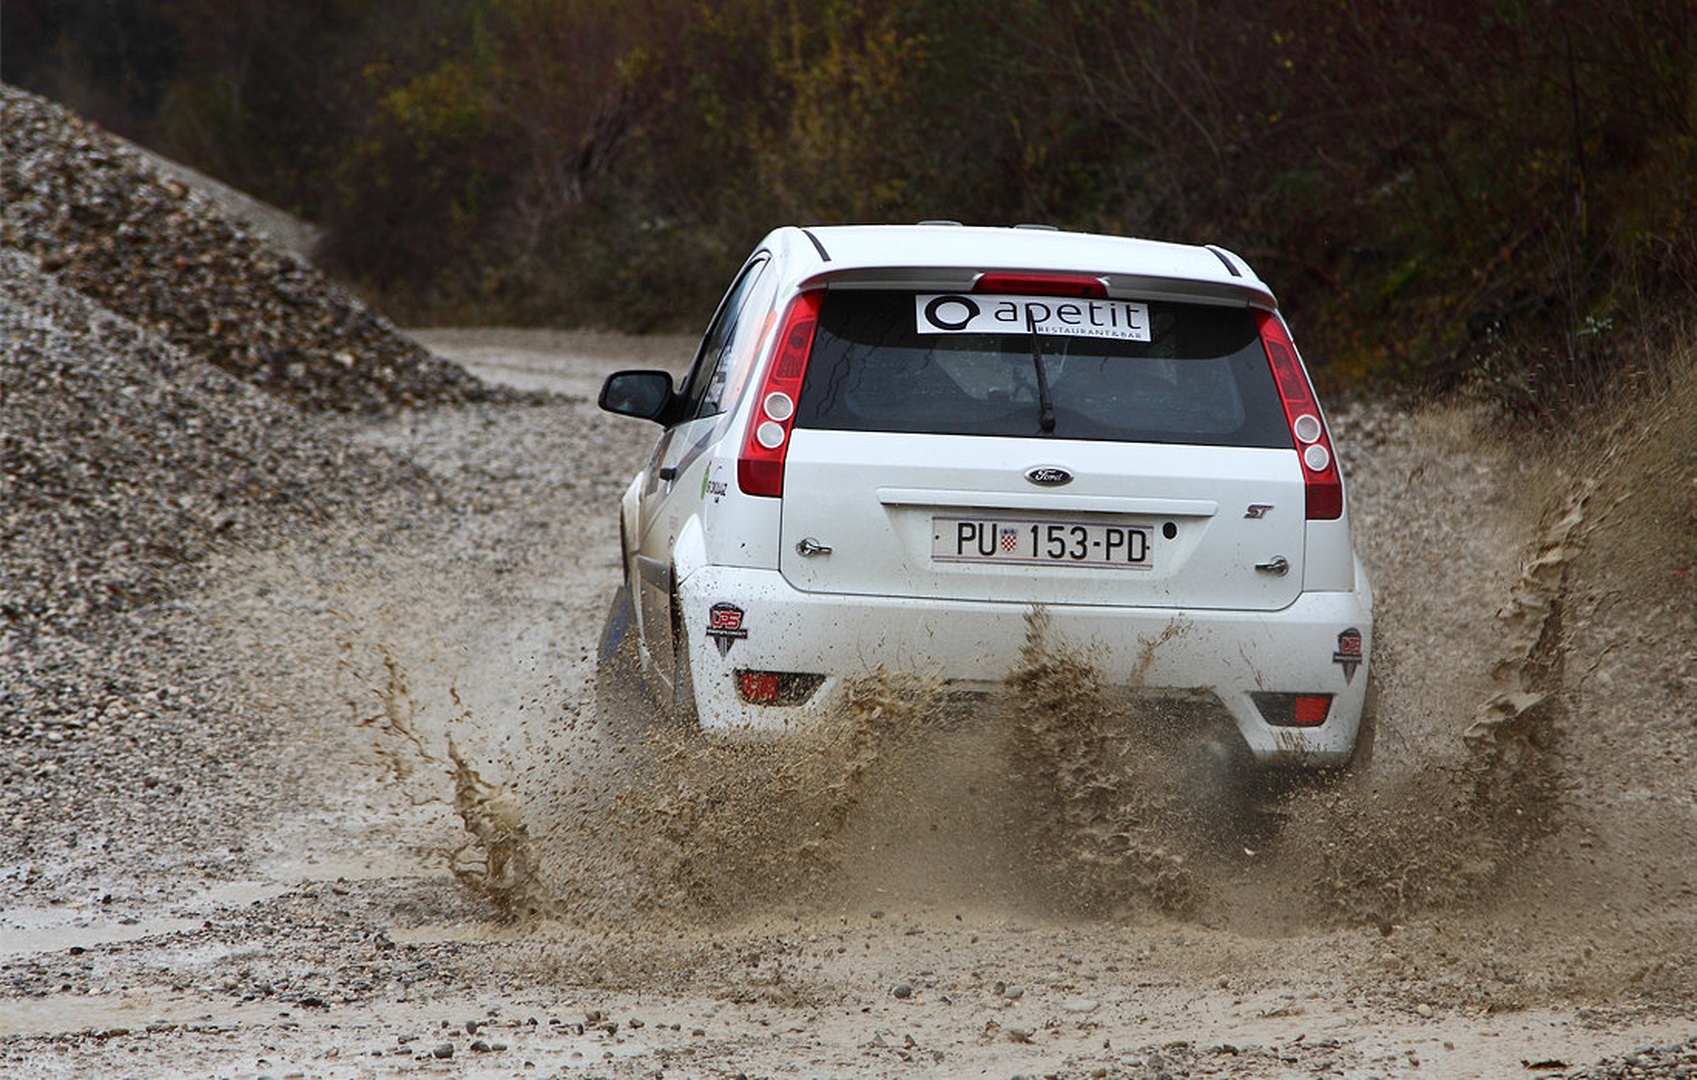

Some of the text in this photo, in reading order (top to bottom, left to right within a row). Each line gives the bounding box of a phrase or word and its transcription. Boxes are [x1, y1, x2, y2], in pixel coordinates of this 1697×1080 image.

[994, 301, 1142, 332] apetit
[1035, 470, 1064, 481] Ford
[1244, 504, 1275, 519] ST
[957, 522, 1148, 563] PU 153-PD
